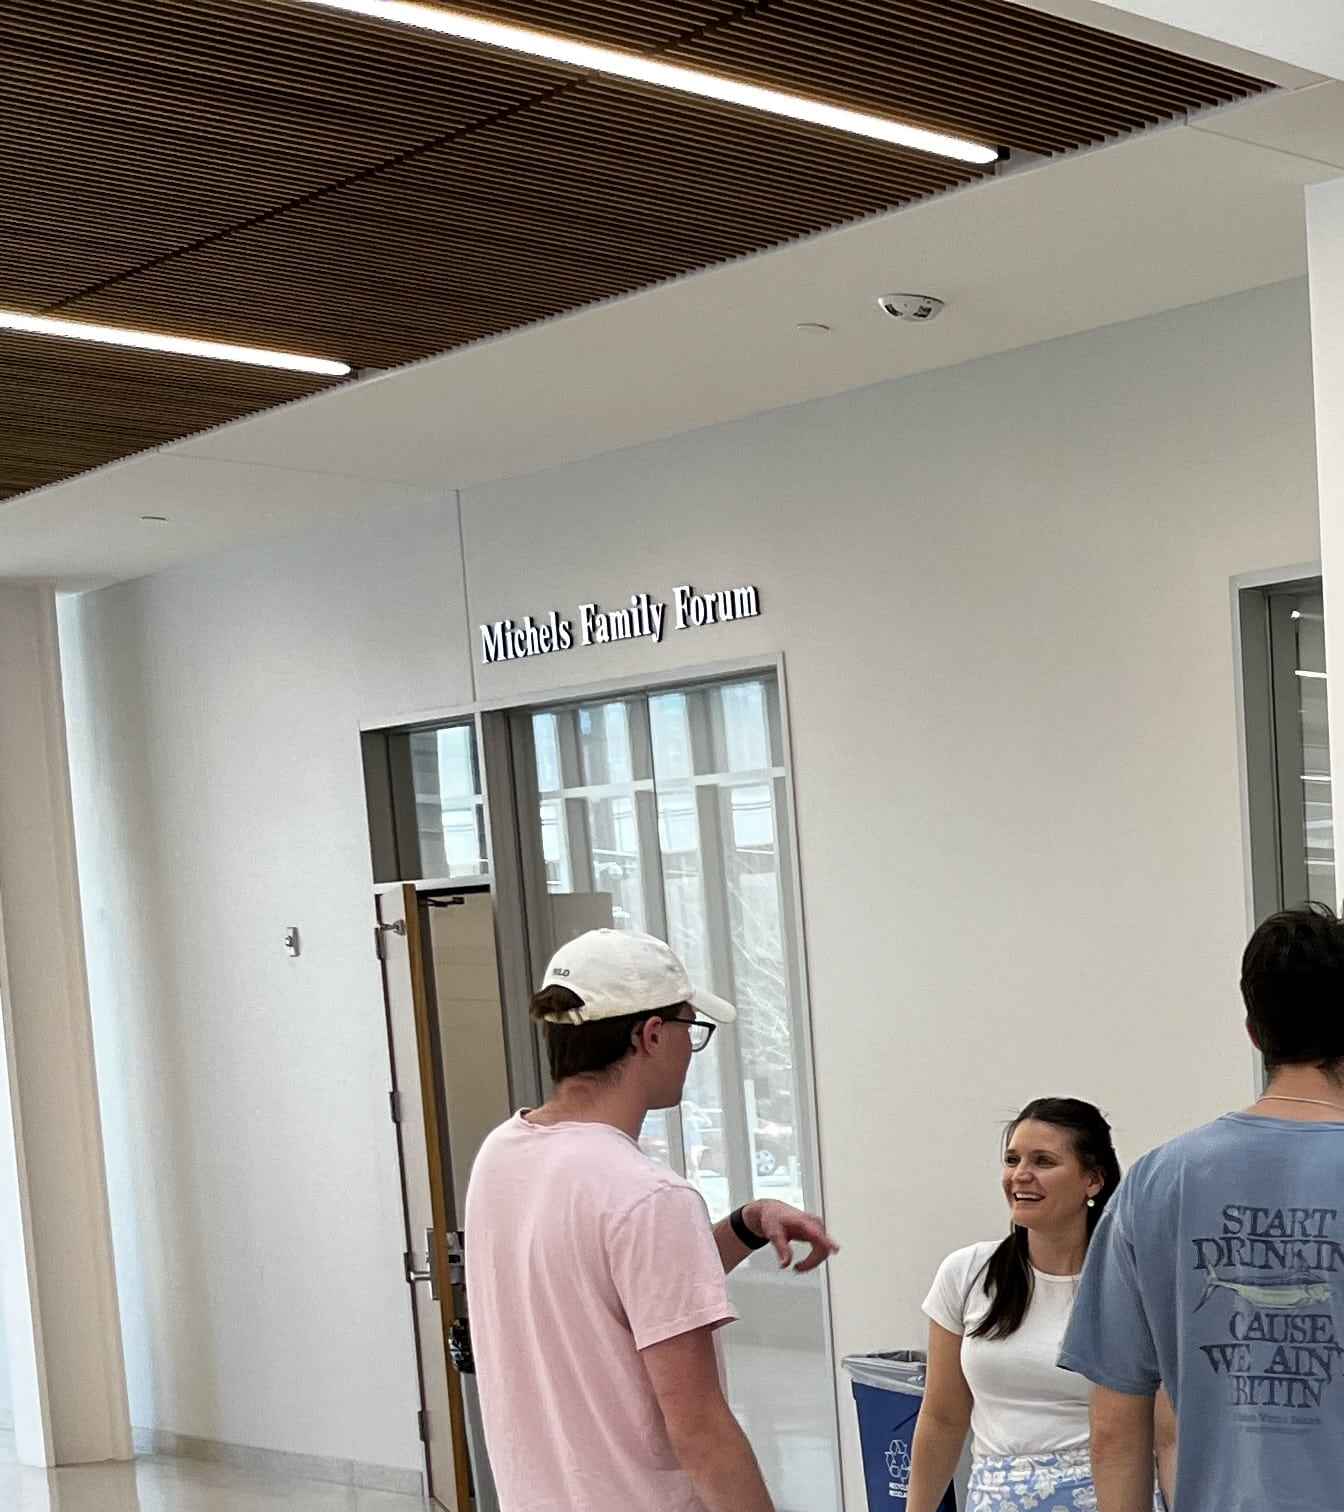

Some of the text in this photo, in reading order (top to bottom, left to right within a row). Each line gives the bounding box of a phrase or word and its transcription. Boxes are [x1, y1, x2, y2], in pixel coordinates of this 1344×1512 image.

[480, 584, 762, 663] Michels Family Forum
[1222, 1204, 1337, 1239] START
[1199, 1343, 1250, 1374] WE
